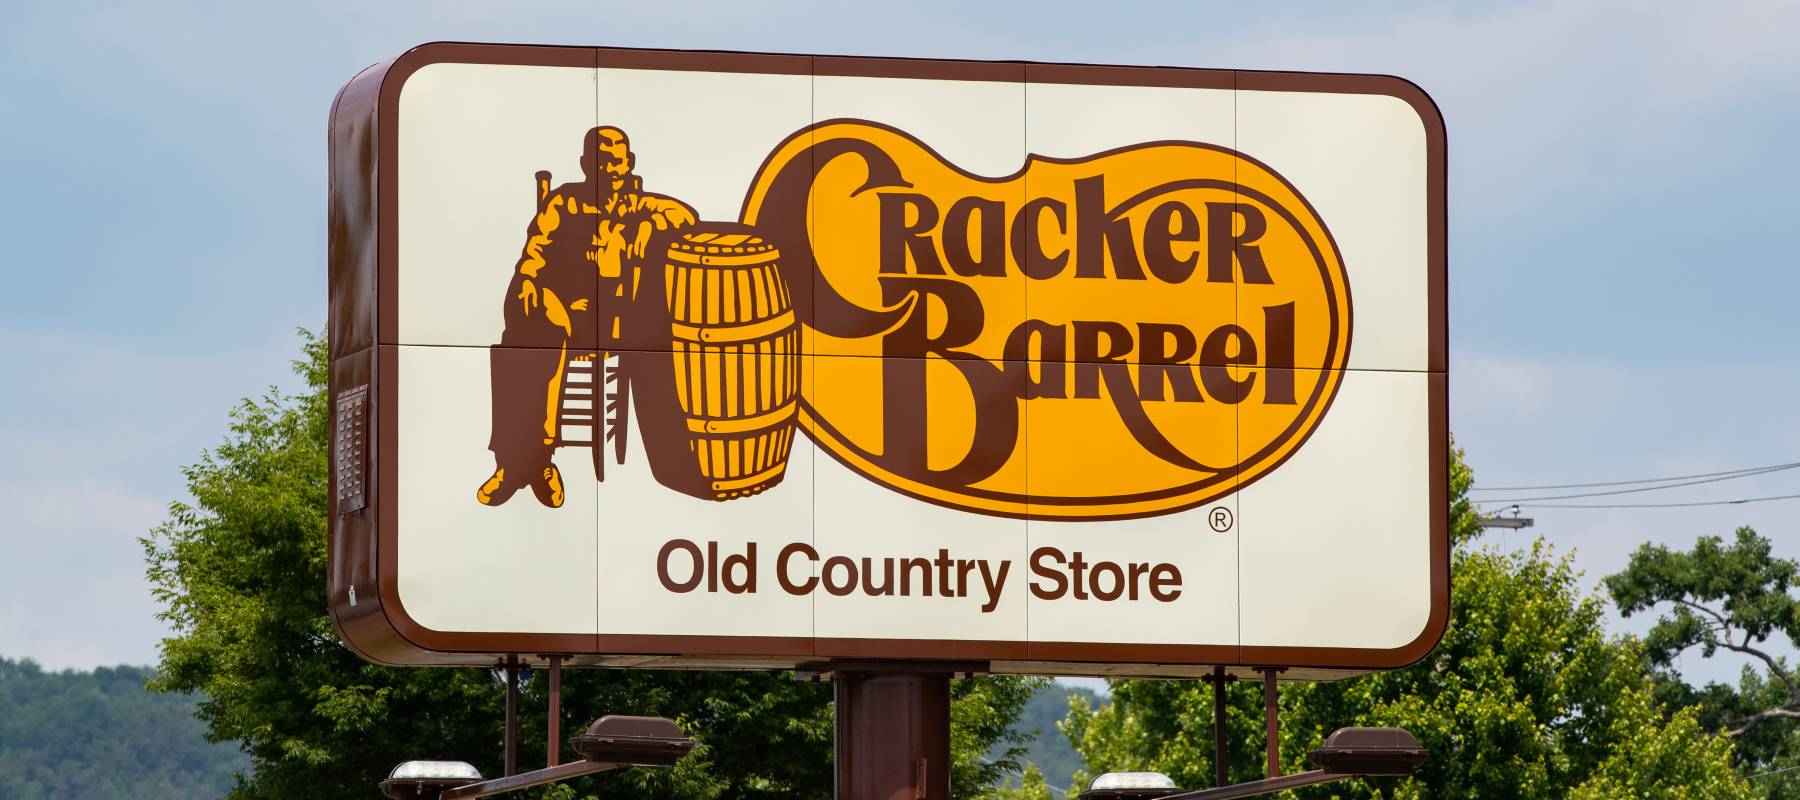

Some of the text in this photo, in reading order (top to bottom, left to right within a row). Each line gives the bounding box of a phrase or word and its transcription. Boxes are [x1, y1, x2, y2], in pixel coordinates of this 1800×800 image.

[656, 538, 1183, 613] Old Country Store
